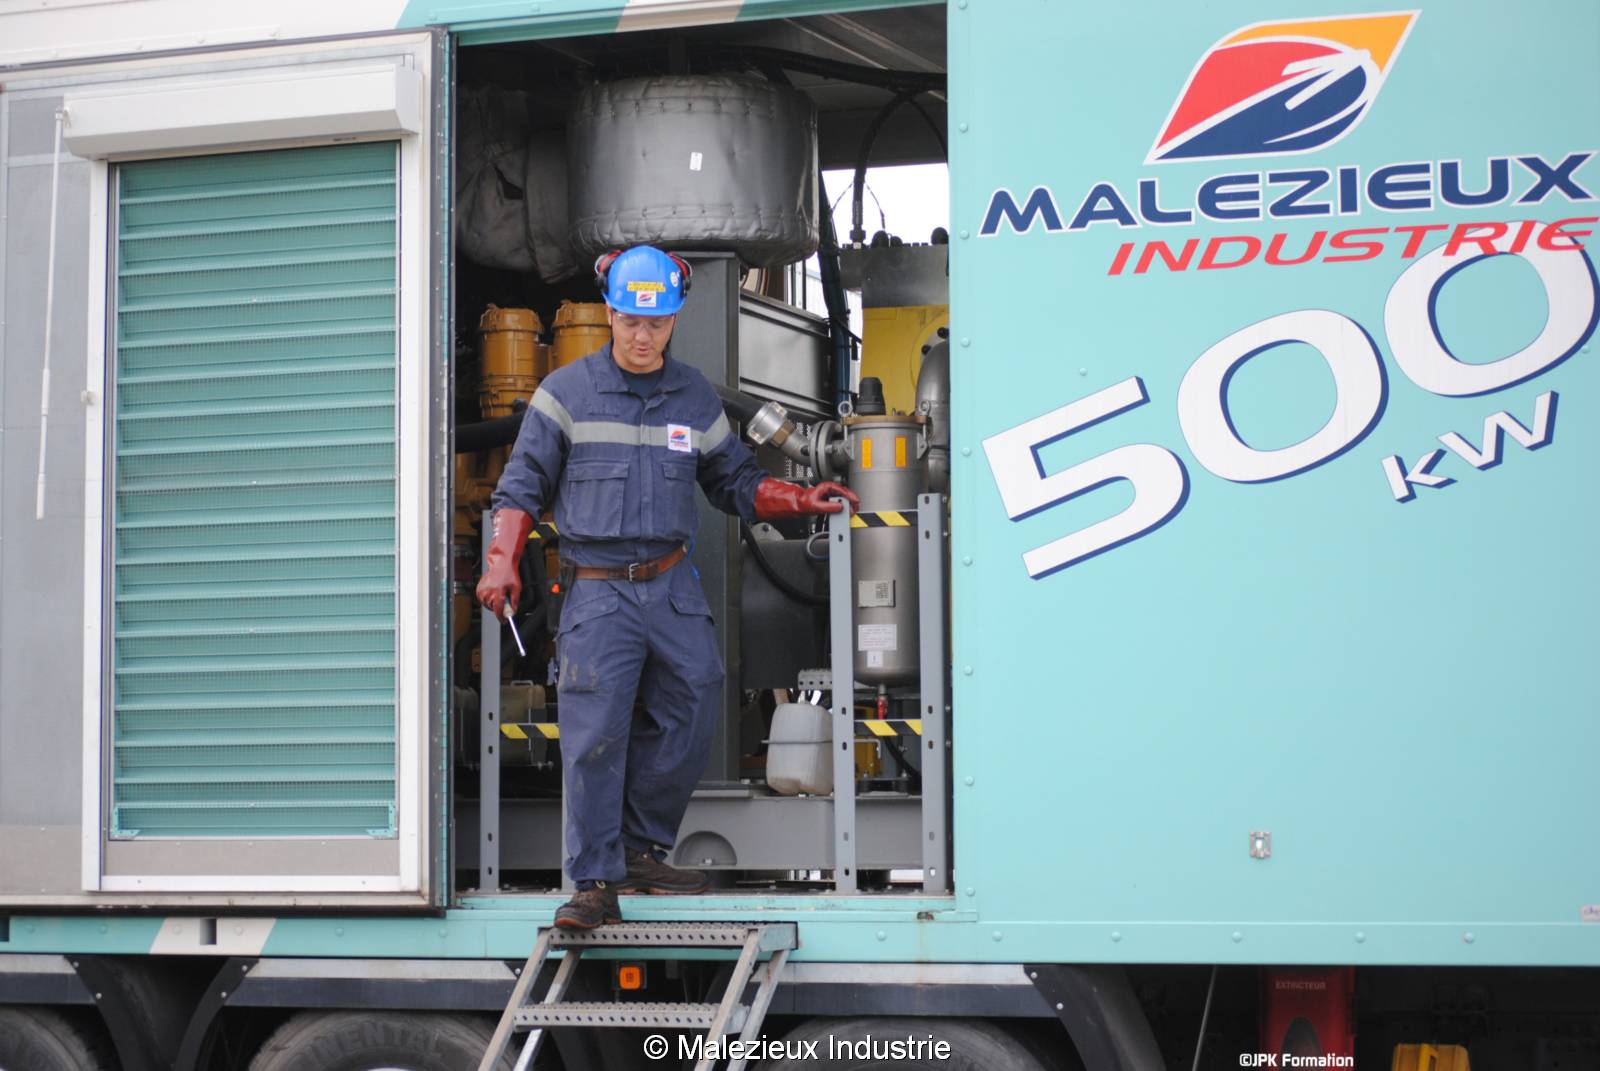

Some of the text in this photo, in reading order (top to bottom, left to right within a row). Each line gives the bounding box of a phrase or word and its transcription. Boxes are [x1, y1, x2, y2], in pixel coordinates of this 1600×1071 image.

[977, 151, 1600, 237] MALEZIEUX
[1107, 216, 1600, 276] INDUSTRIE
[981, 219, 1600, 581] 500 kW
